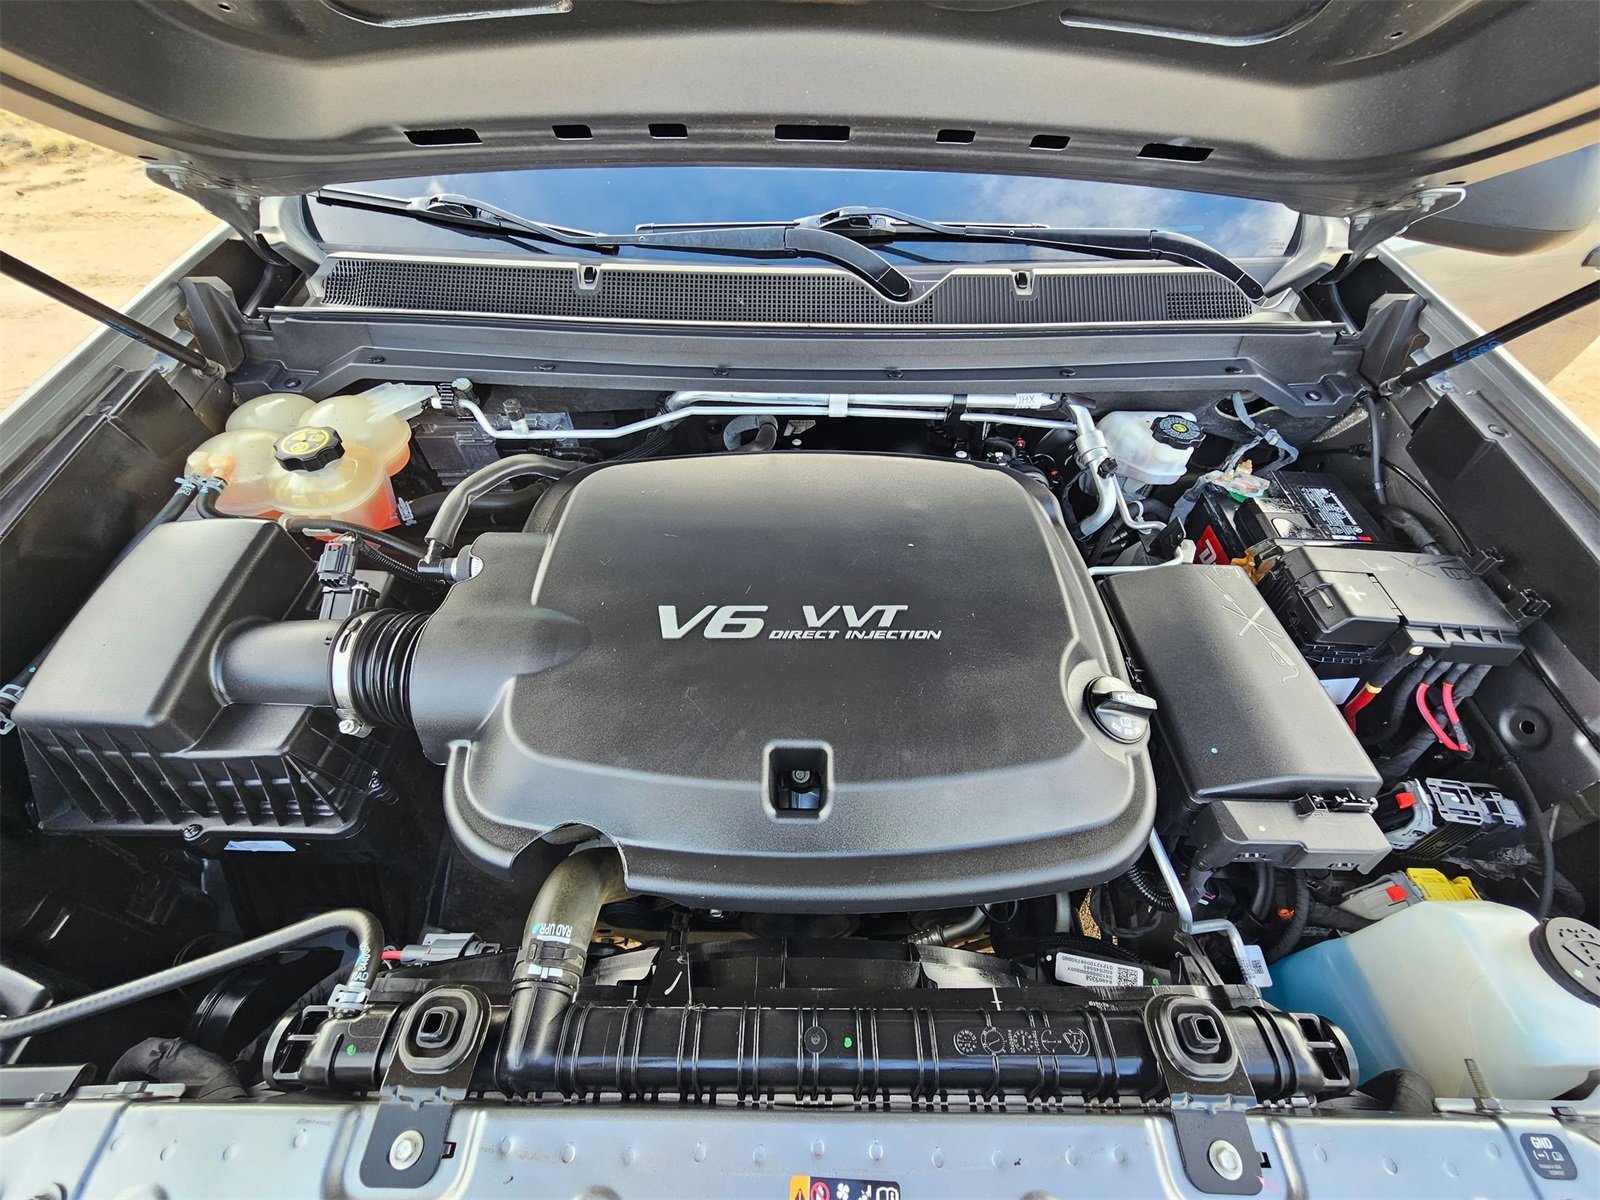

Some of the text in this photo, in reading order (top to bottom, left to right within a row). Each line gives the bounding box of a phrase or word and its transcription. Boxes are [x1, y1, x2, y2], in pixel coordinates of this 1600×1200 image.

[658, 605, 908, 639] V6 VVT
[768, 630, 942, 639] DIRECT INJECTION
[539, 922, 573, 937] RAD UPR
[350, 972, 369, 981] RAD
[1530, 1136, 1553, 1149] GND
